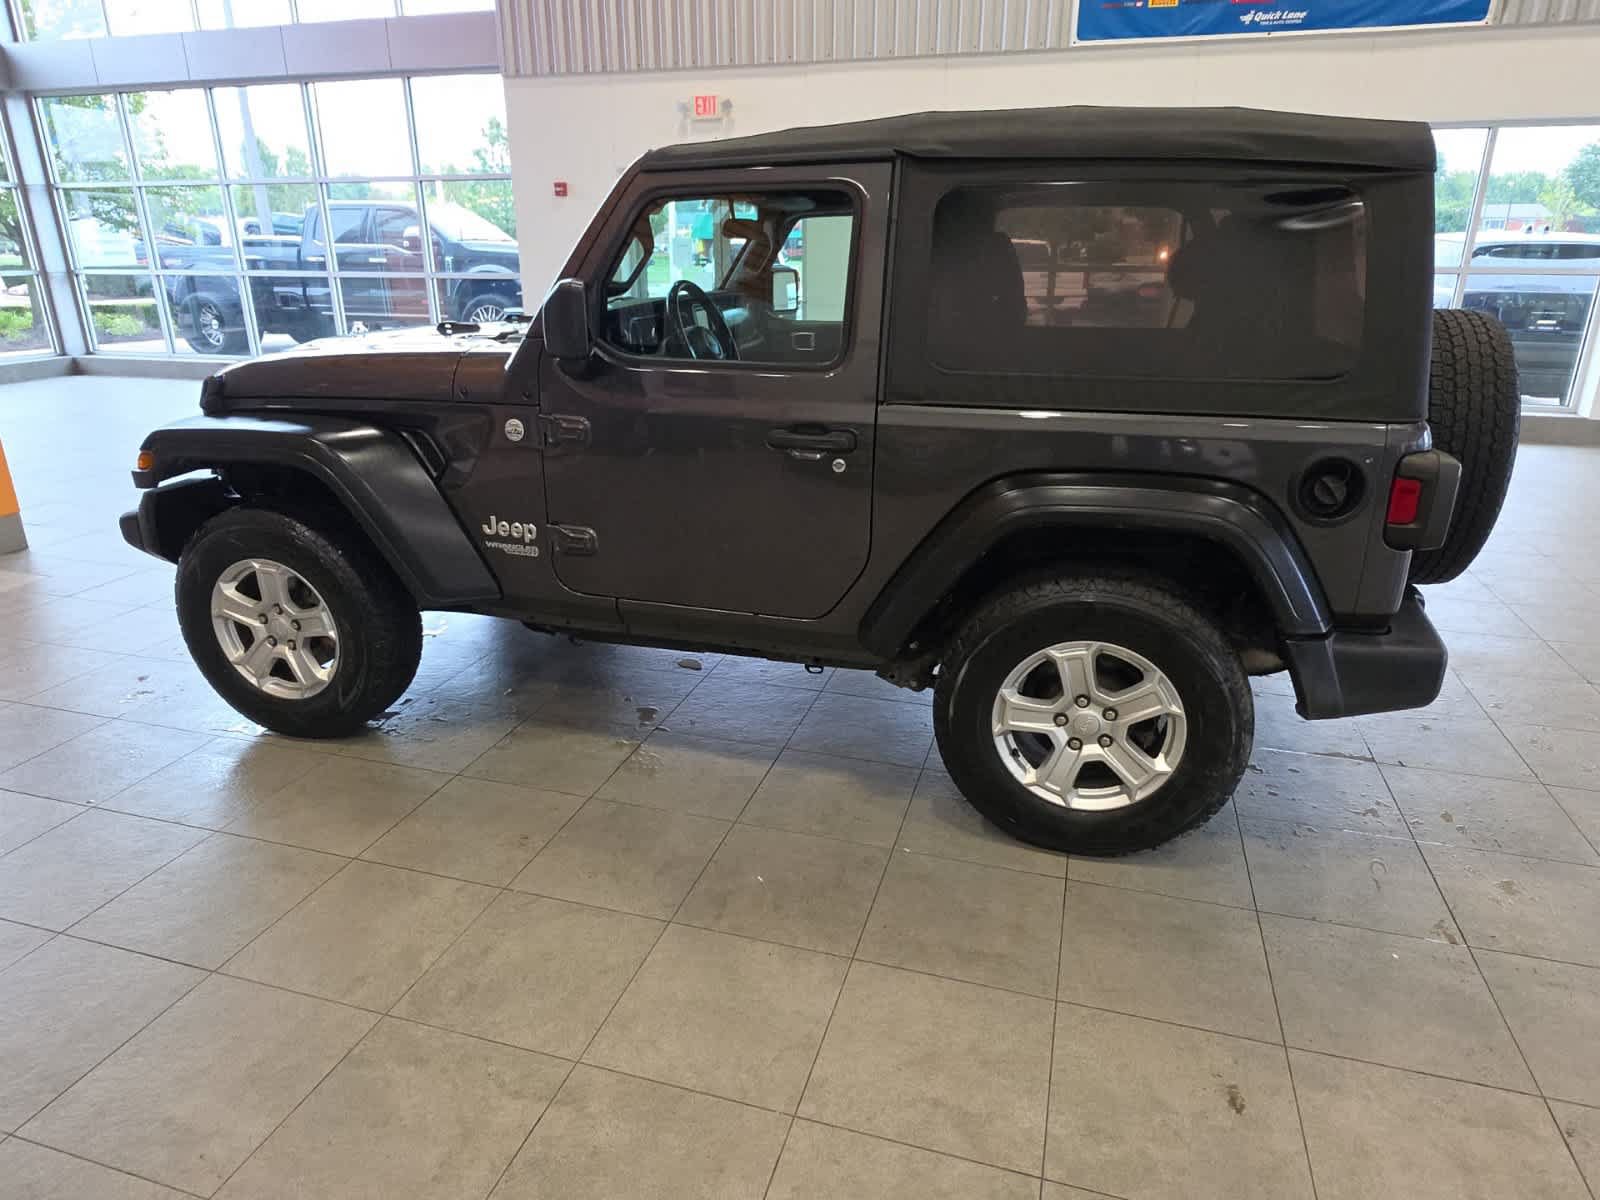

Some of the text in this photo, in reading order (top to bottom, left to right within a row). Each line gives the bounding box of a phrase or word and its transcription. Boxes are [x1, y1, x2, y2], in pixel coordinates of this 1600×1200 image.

[1254, 10, 1308, 22] Quick Lane
[695, 96, 717, 116] EXIT
[482, 515, 537, 543] Jeep
